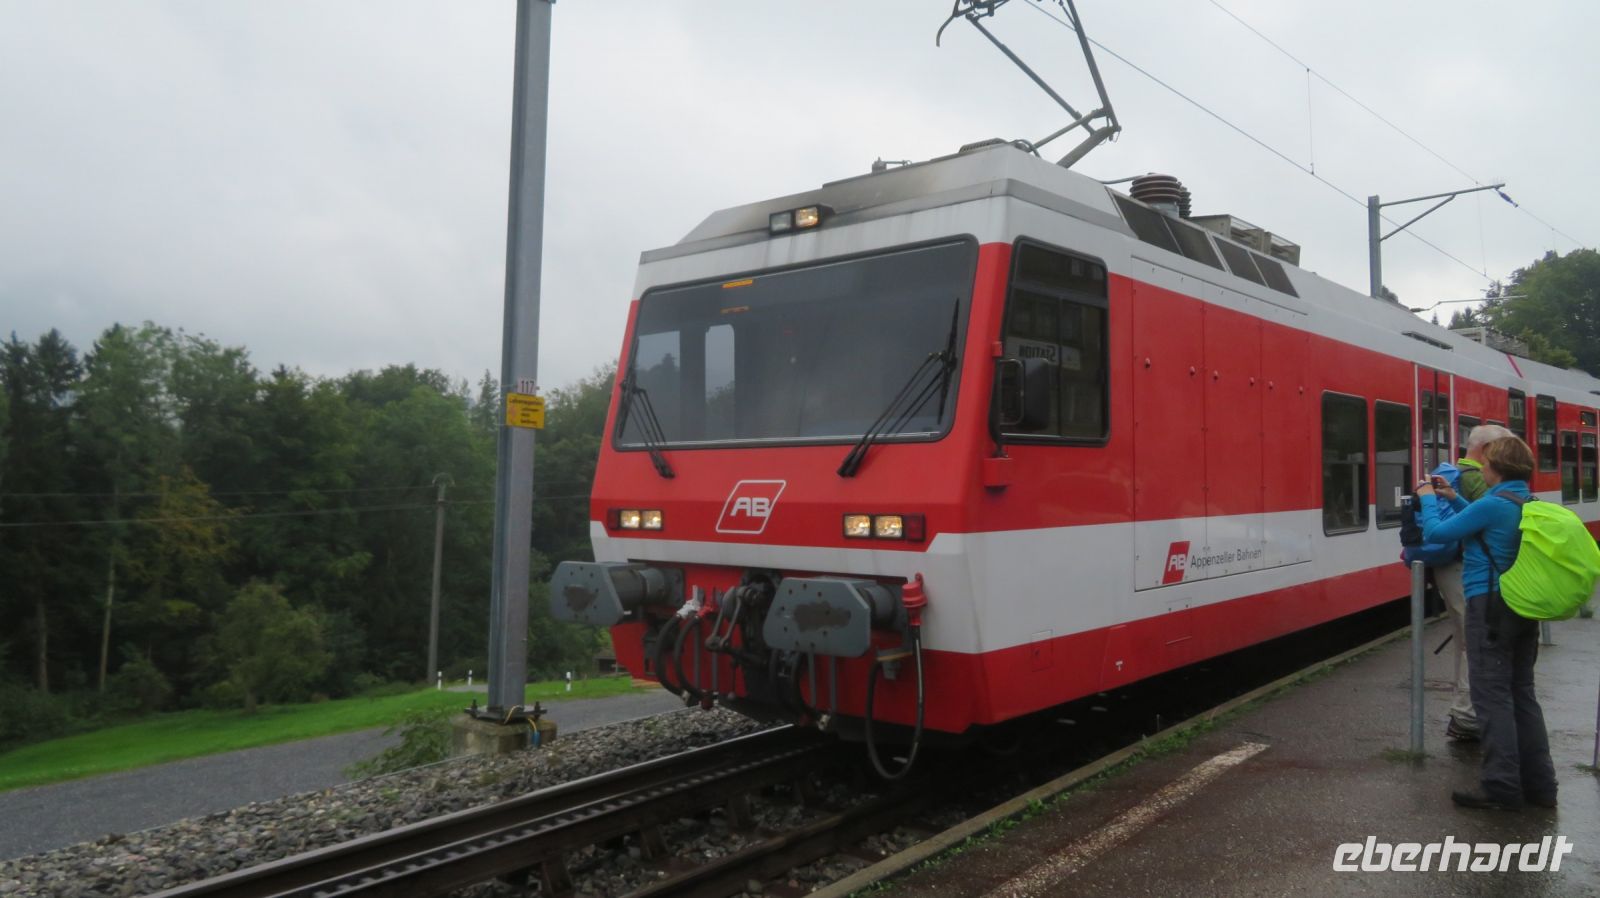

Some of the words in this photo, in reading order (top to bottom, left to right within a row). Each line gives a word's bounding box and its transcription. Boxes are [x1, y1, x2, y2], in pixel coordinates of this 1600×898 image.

[521, 380, 535, 394] 117
[730, 497, 770, 517] AB
[1168, 554, 1186, 571] AB
[1191, 551, 1235, 569] Appenzeller
[1237, 548, 1262, 561] Bahnen
